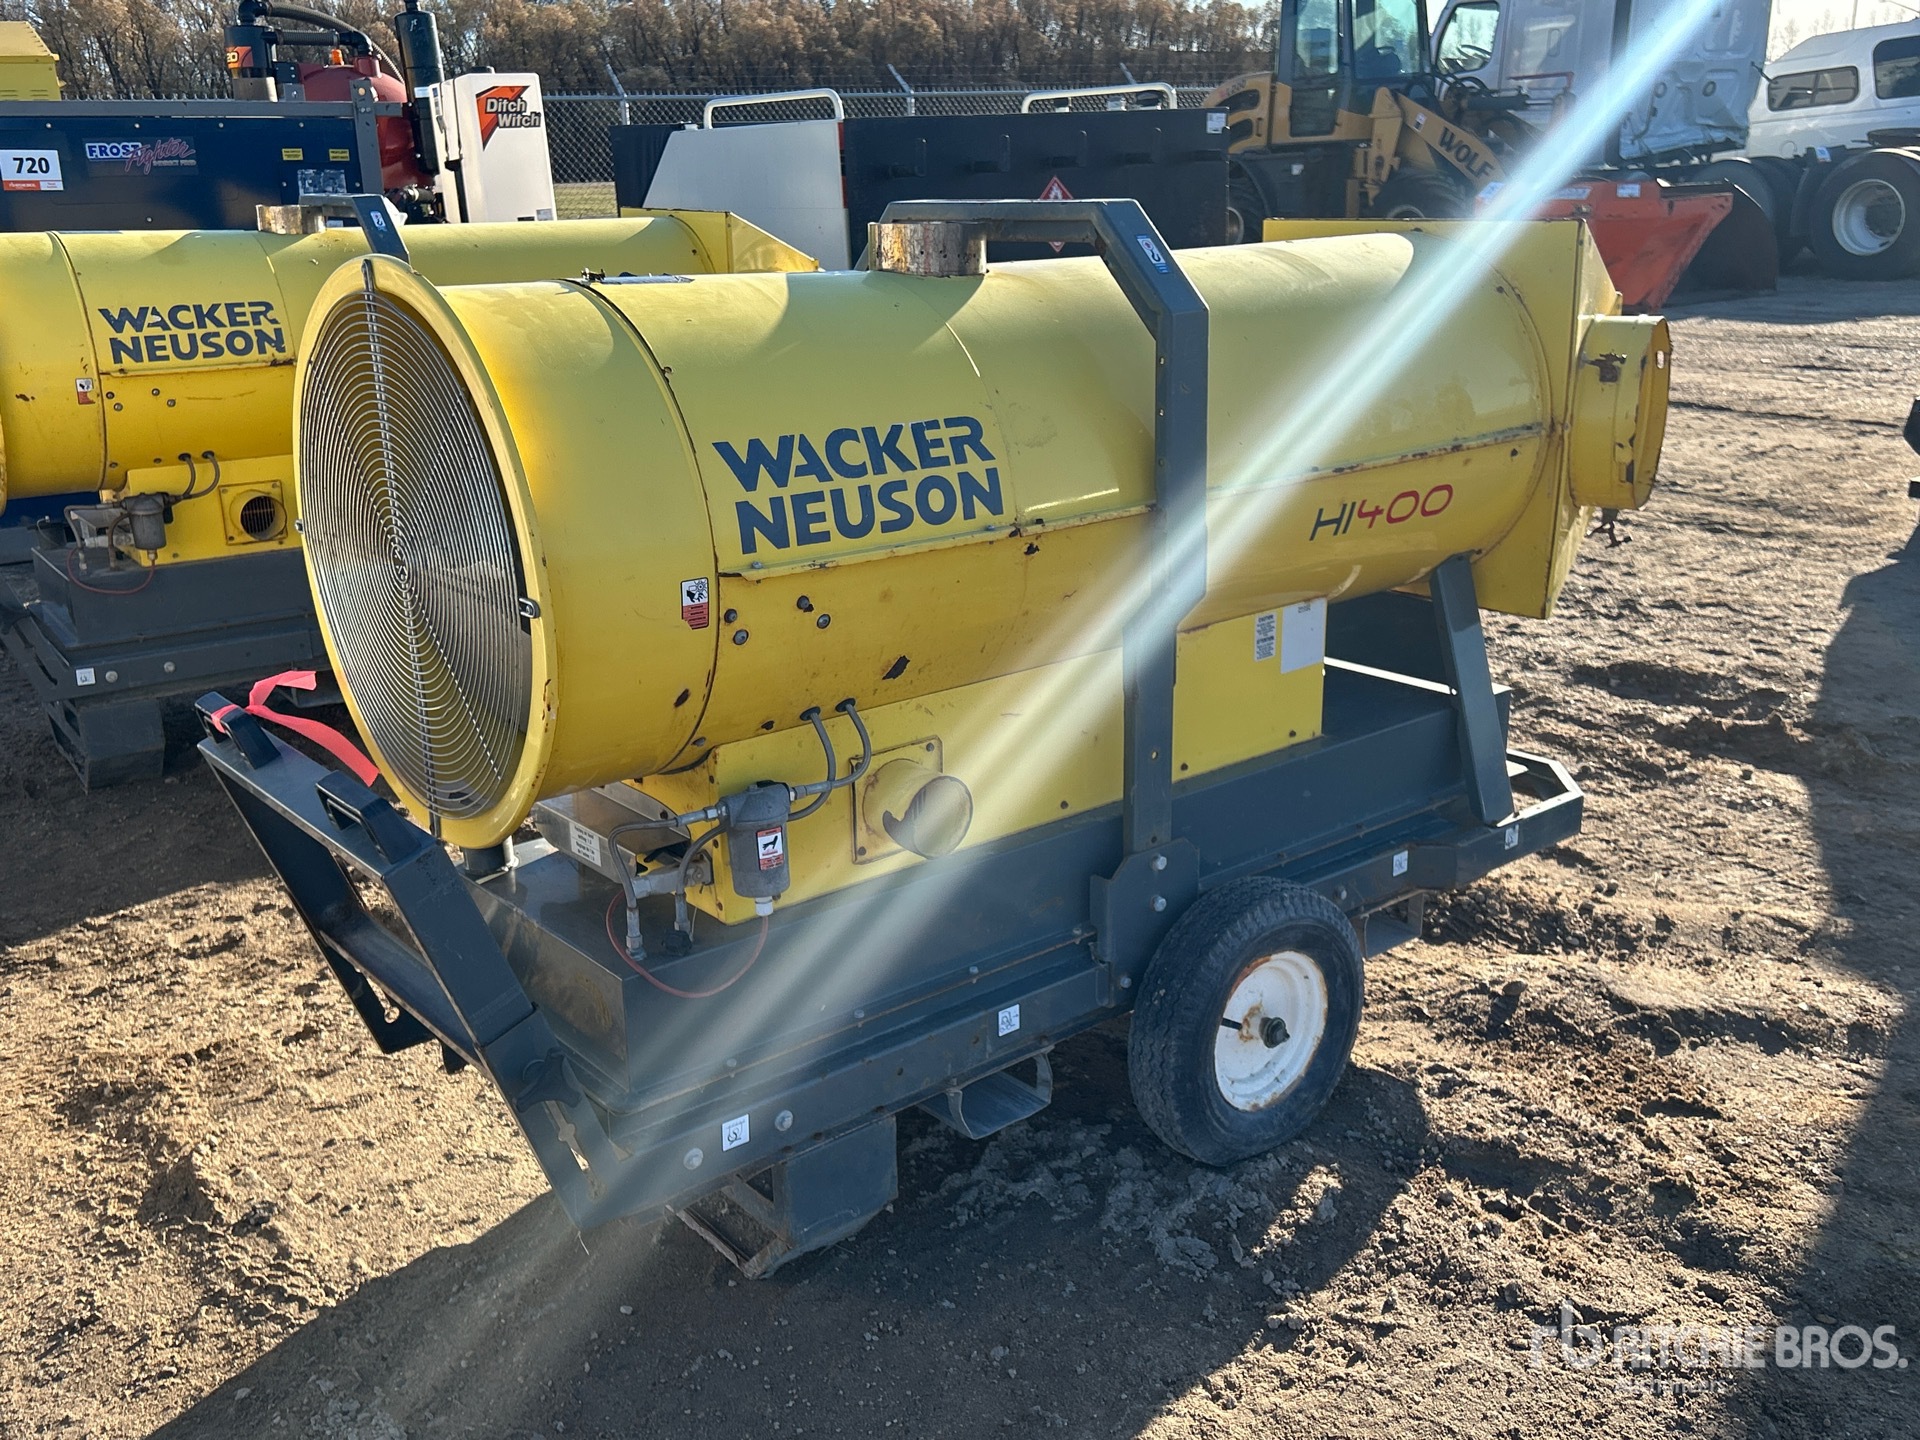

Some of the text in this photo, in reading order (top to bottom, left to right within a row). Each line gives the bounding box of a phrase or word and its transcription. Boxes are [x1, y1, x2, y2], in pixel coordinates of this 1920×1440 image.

[486, 98, 527, 113] Ditch
[498, 113, 541, 128] Witch
[12, 157, 50, 174] 720
[86, 138, 196, 174] FROST Fighter
[1437, 126, 1494, 179] WOLF
[98, 301, 280, 333] WACKER
[109, 327, 286, 365] NEUSON
[712, 416, 996, 492] WACKER
[735, 467, 1004, 555] NEUSON
[1309, 484, 1454, 541] HI400
